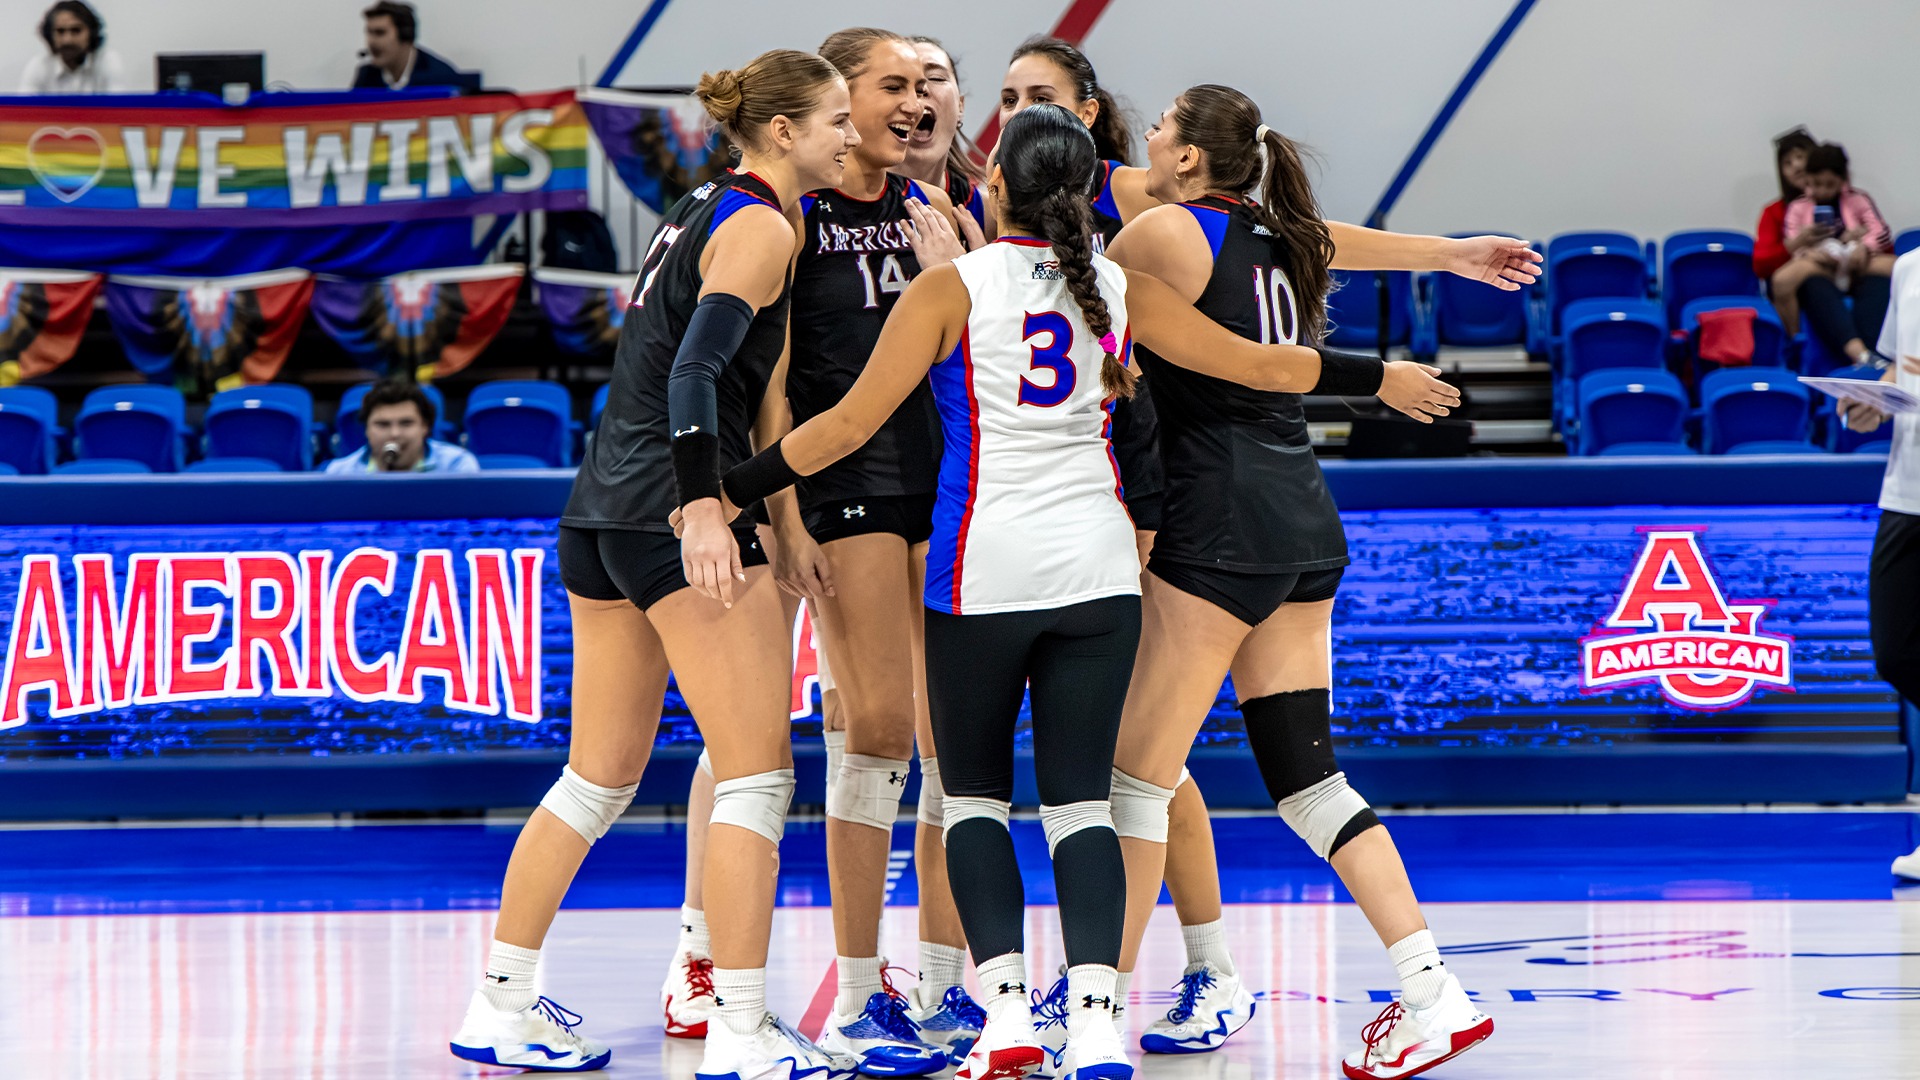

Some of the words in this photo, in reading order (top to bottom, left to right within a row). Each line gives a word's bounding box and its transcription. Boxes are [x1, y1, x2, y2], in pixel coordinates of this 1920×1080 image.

[283, 108, 554, 208] WINS
[856, 252, 911, 309] 14
[1252, 264, 1298, 345] 10
[1017, 310, 1077, 408] 3
[0, 547, 543, 730] AMERICAN
[1597, 640, 1780, 673] AMERICAN
